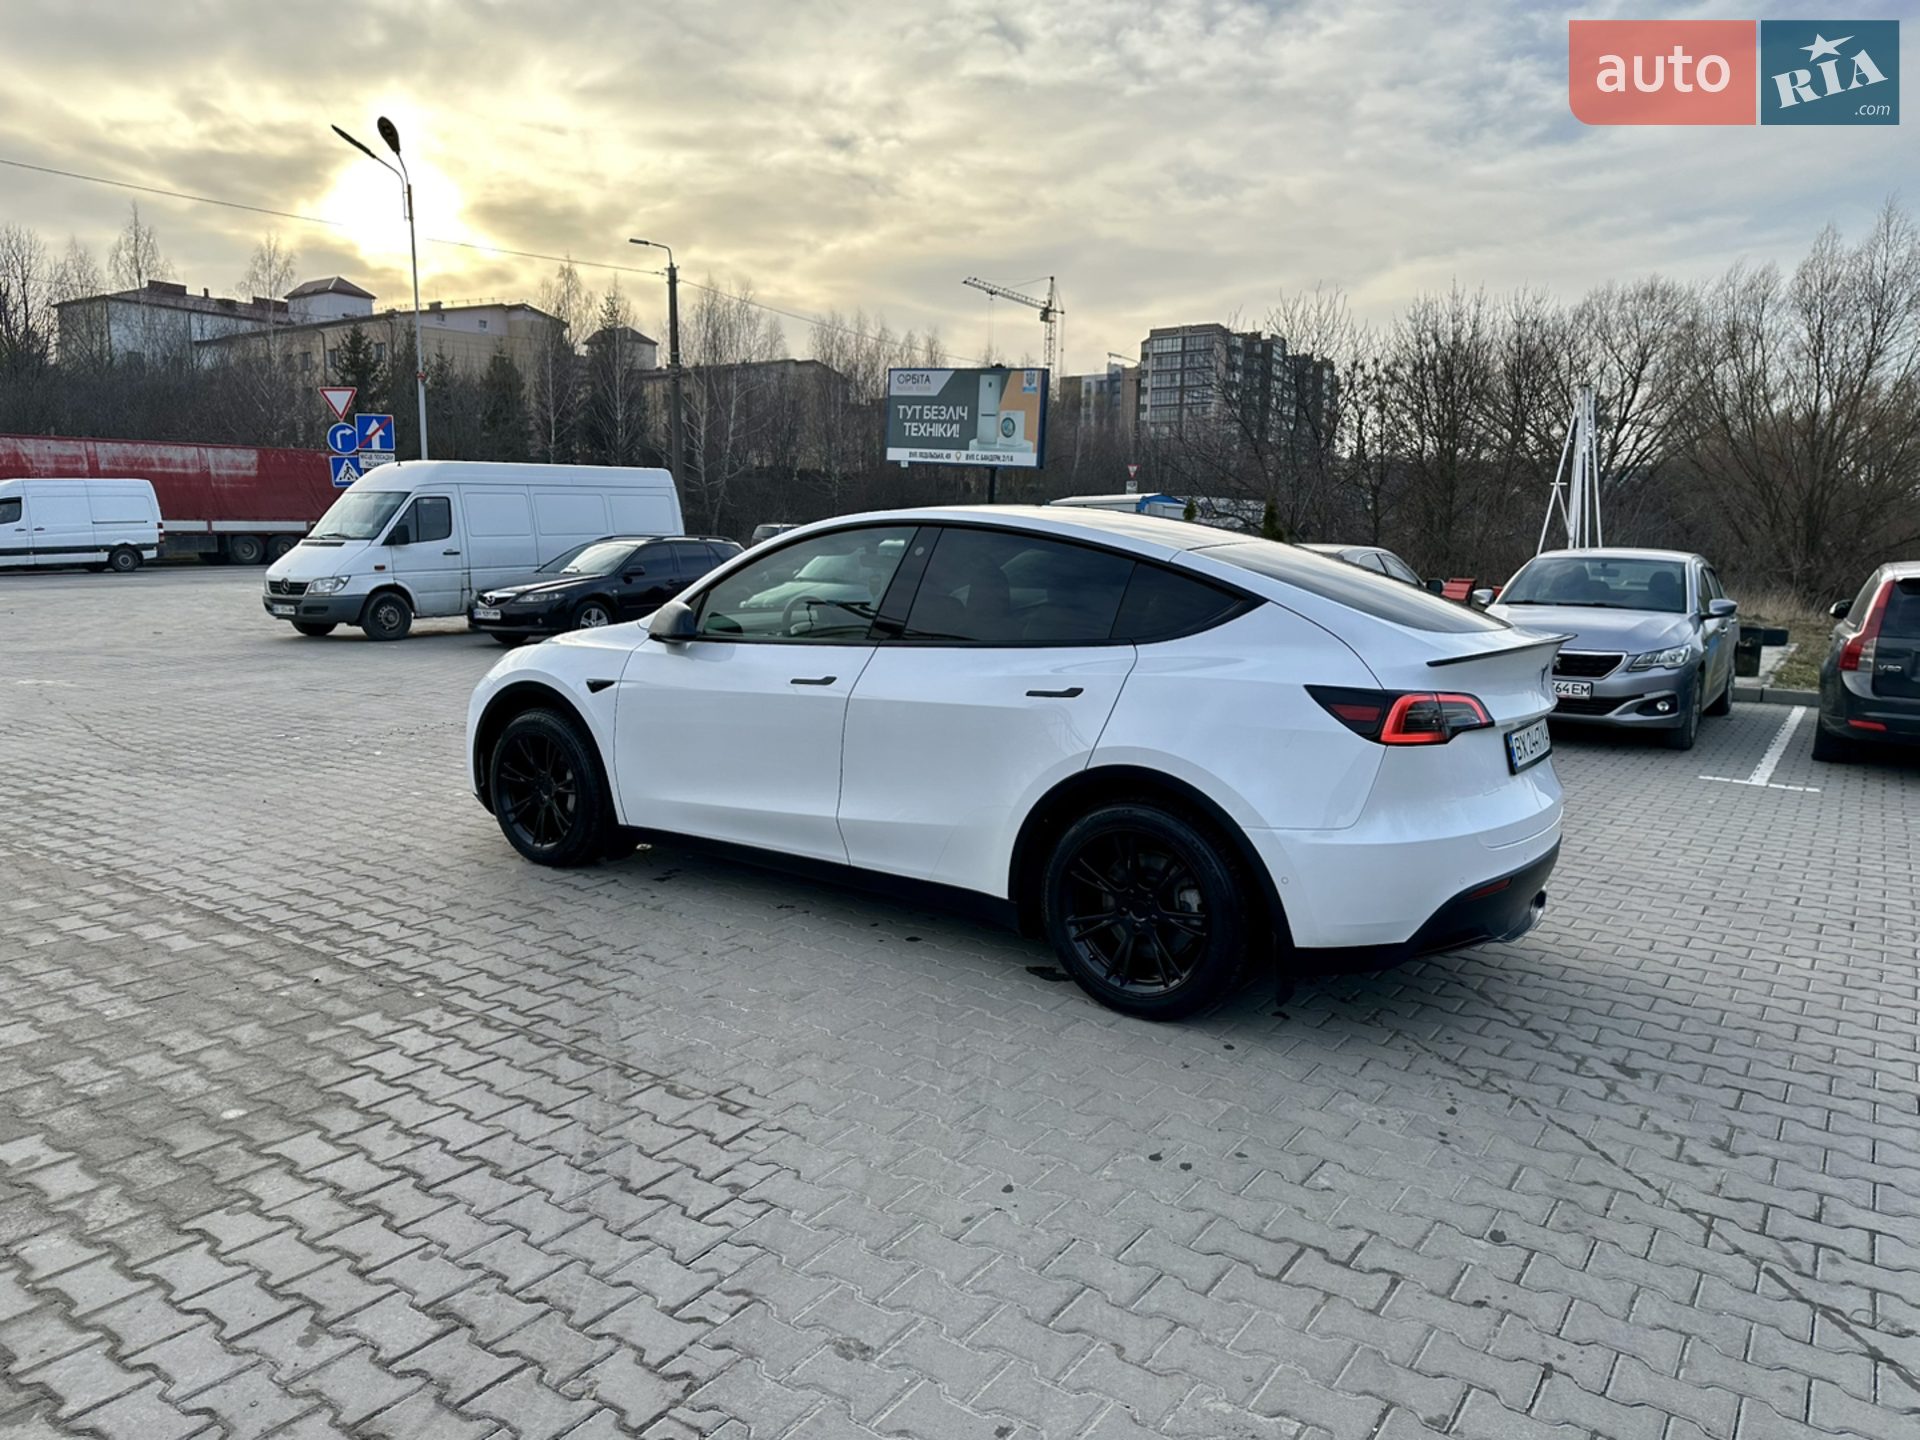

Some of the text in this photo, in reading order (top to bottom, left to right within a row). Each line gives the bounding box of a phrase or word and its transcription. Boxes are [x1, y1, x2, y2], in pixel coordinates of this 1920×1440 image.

[897, 373, 931, 385] ОРБІТА
[897, 405, 968, 421] ТУТ БЕЗЛІЧ
[903, 422, 960, 438] ТЕХНІКИ!
